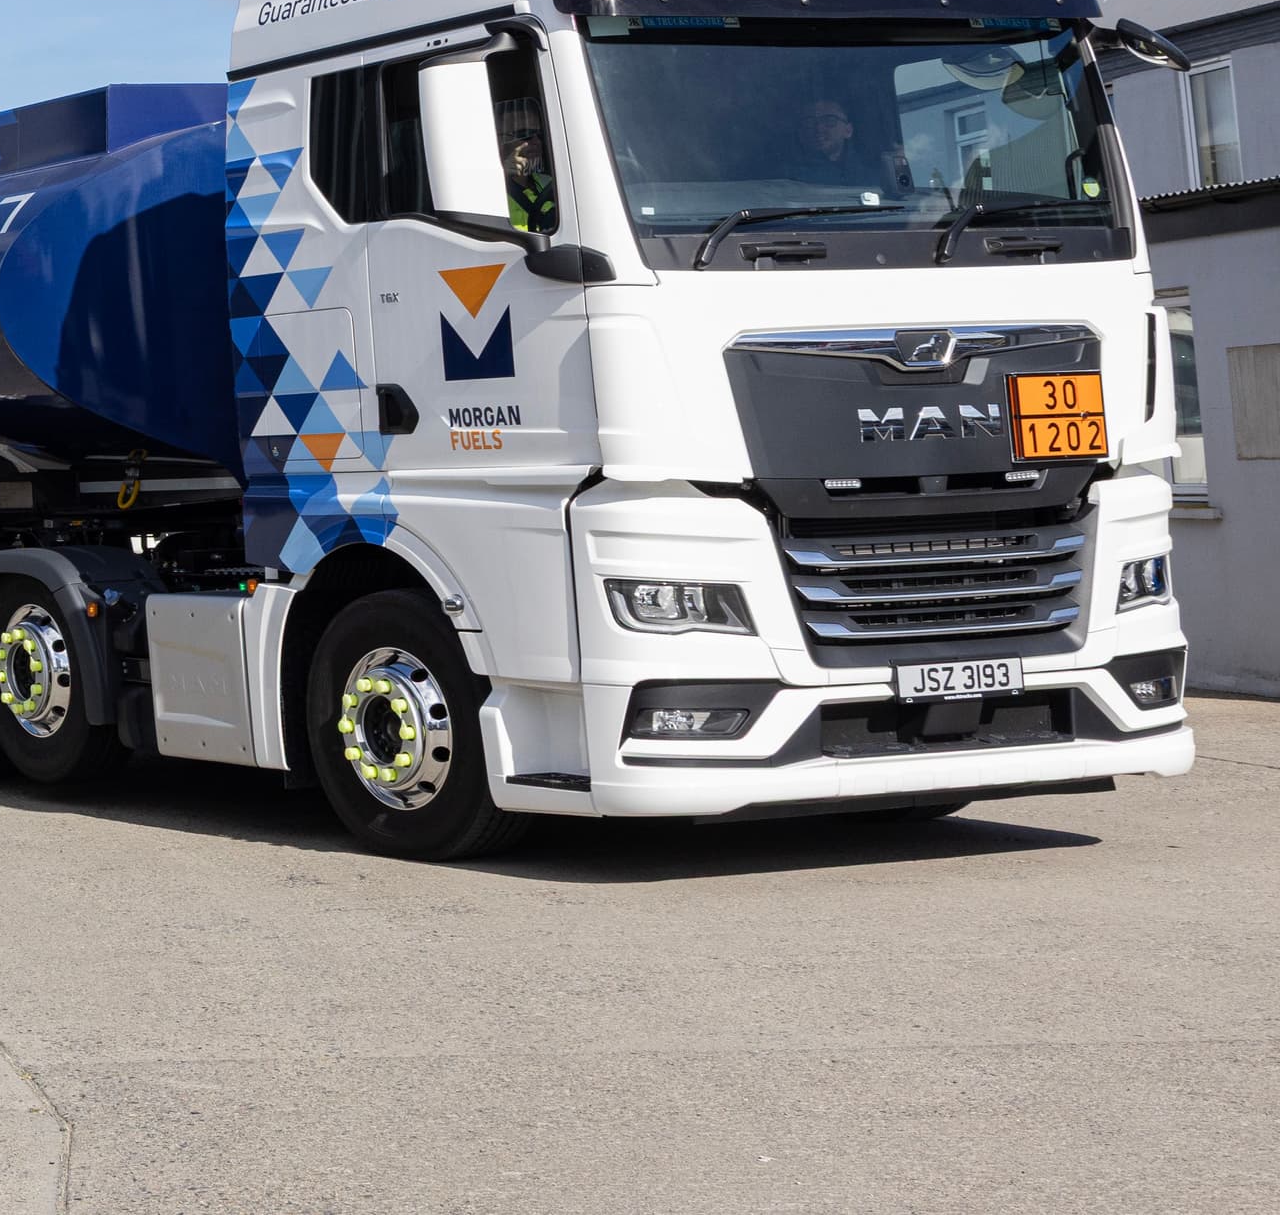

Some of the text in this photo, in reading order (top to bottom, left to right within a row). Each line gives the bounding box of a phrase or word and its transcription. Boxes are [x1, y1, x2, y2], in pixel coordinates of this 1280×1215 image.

[0, 192, 37, 234] 7
[380, 292, 400, 304] TGX
[1044, 380, 1077, 410] 30
[449, 405, 521, 429] MORGAN
[858, 404, 1002, 442] MAN
[450, 429, 503, 451] FUELS
[1029, 420, 1102, 453] 1202
[913, 663, 1010, 693] JSZ 3193
